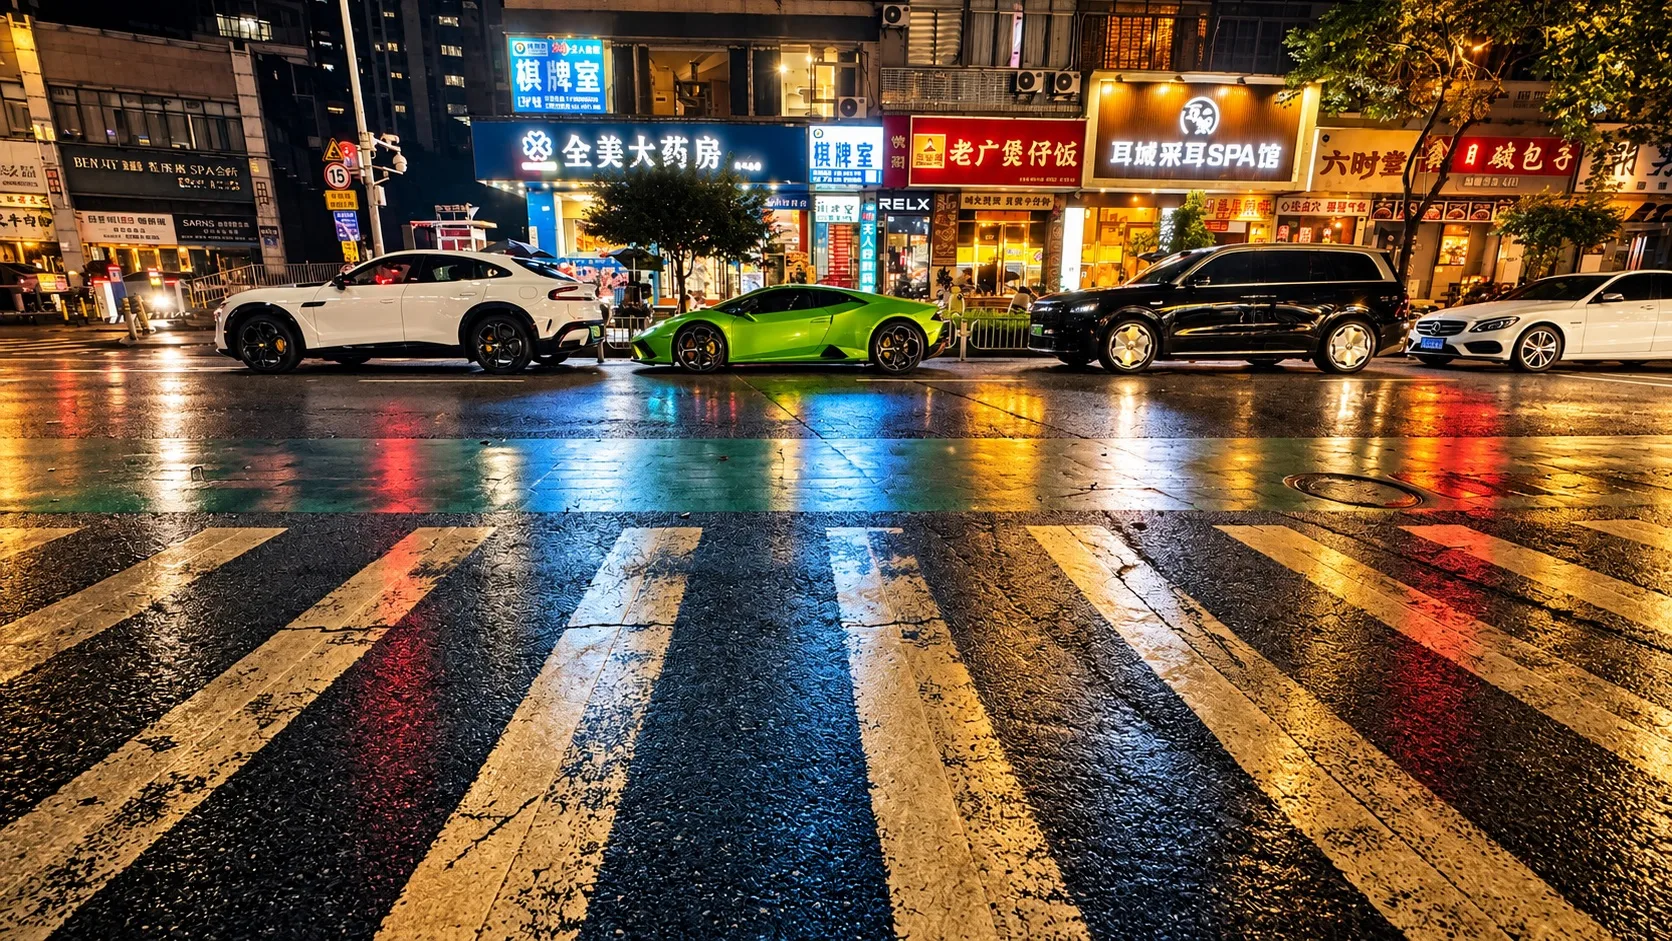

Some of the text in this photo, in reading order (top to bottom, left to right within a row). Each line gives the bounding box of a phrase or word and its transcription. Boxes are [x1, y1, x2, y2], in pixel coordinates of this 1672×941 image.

[516, 59, 600, 92] 棋牌室
[562, 134, 722, 168] 全美大药房
[814, 141, 873, 168] 棋牌室
[950, 139, 1078, 167] 老广煲仔饭
[1110, 141, 1282, 168] 耳城采耳SPA馆
[329, 169, 345, 183] 15
[1320, 150, 1407, 180] 六时堂
[879, 198, 930, 211] RELX
